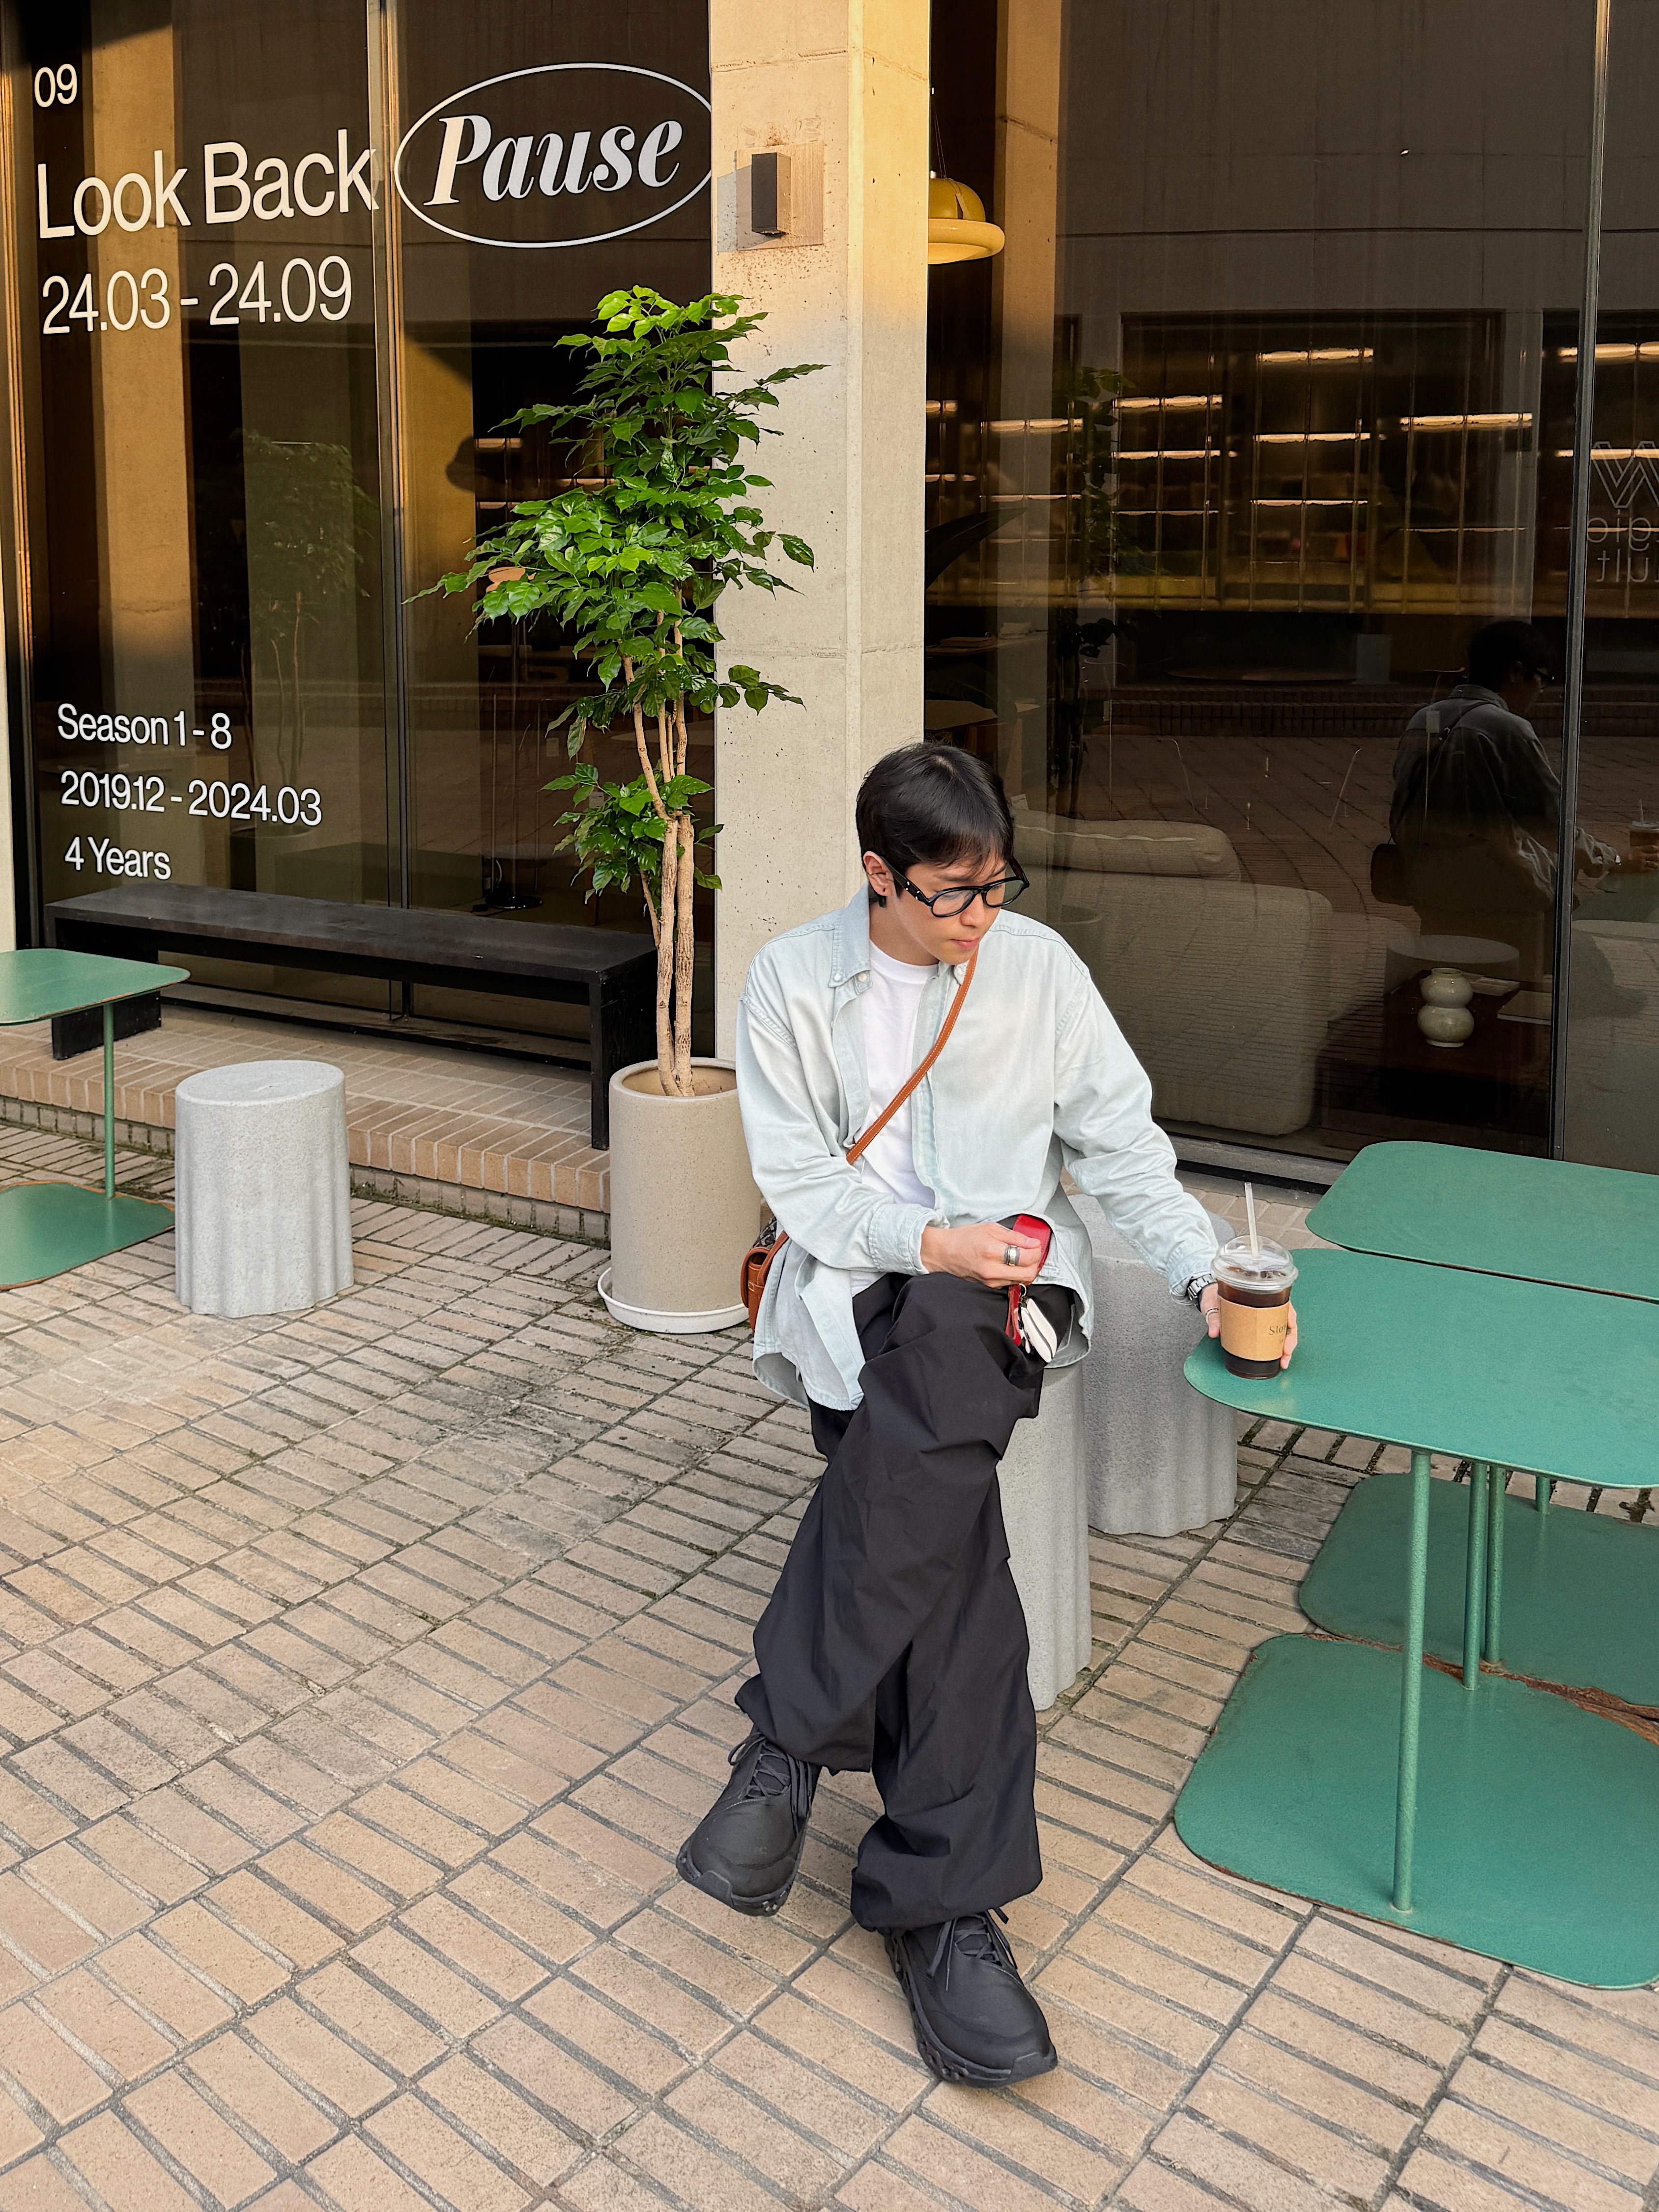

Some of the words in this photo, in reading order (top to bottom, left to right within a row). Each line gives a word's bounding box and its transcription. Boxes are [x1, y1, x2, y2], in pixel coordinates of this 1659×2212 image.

[34, 63, 77, 107] 09
[38, 150, 191, 239] Look
[204, 129, 379, 224] Back
[423, 115, 682, 206] Pause
[43, 268, 170, 334] 24.03
[209, 255, 352, 326] 24.09
[57, 703, 169, 745] Season
[174, 711, 186, 746] 1
[211, 712, 232, 749] 8
[61, 770, 165, 812] 2019.12
[188, 780, 322, 826] 2024.03
[65, 837, 84, 871] 4
[88, 837, 171, 880] Years
